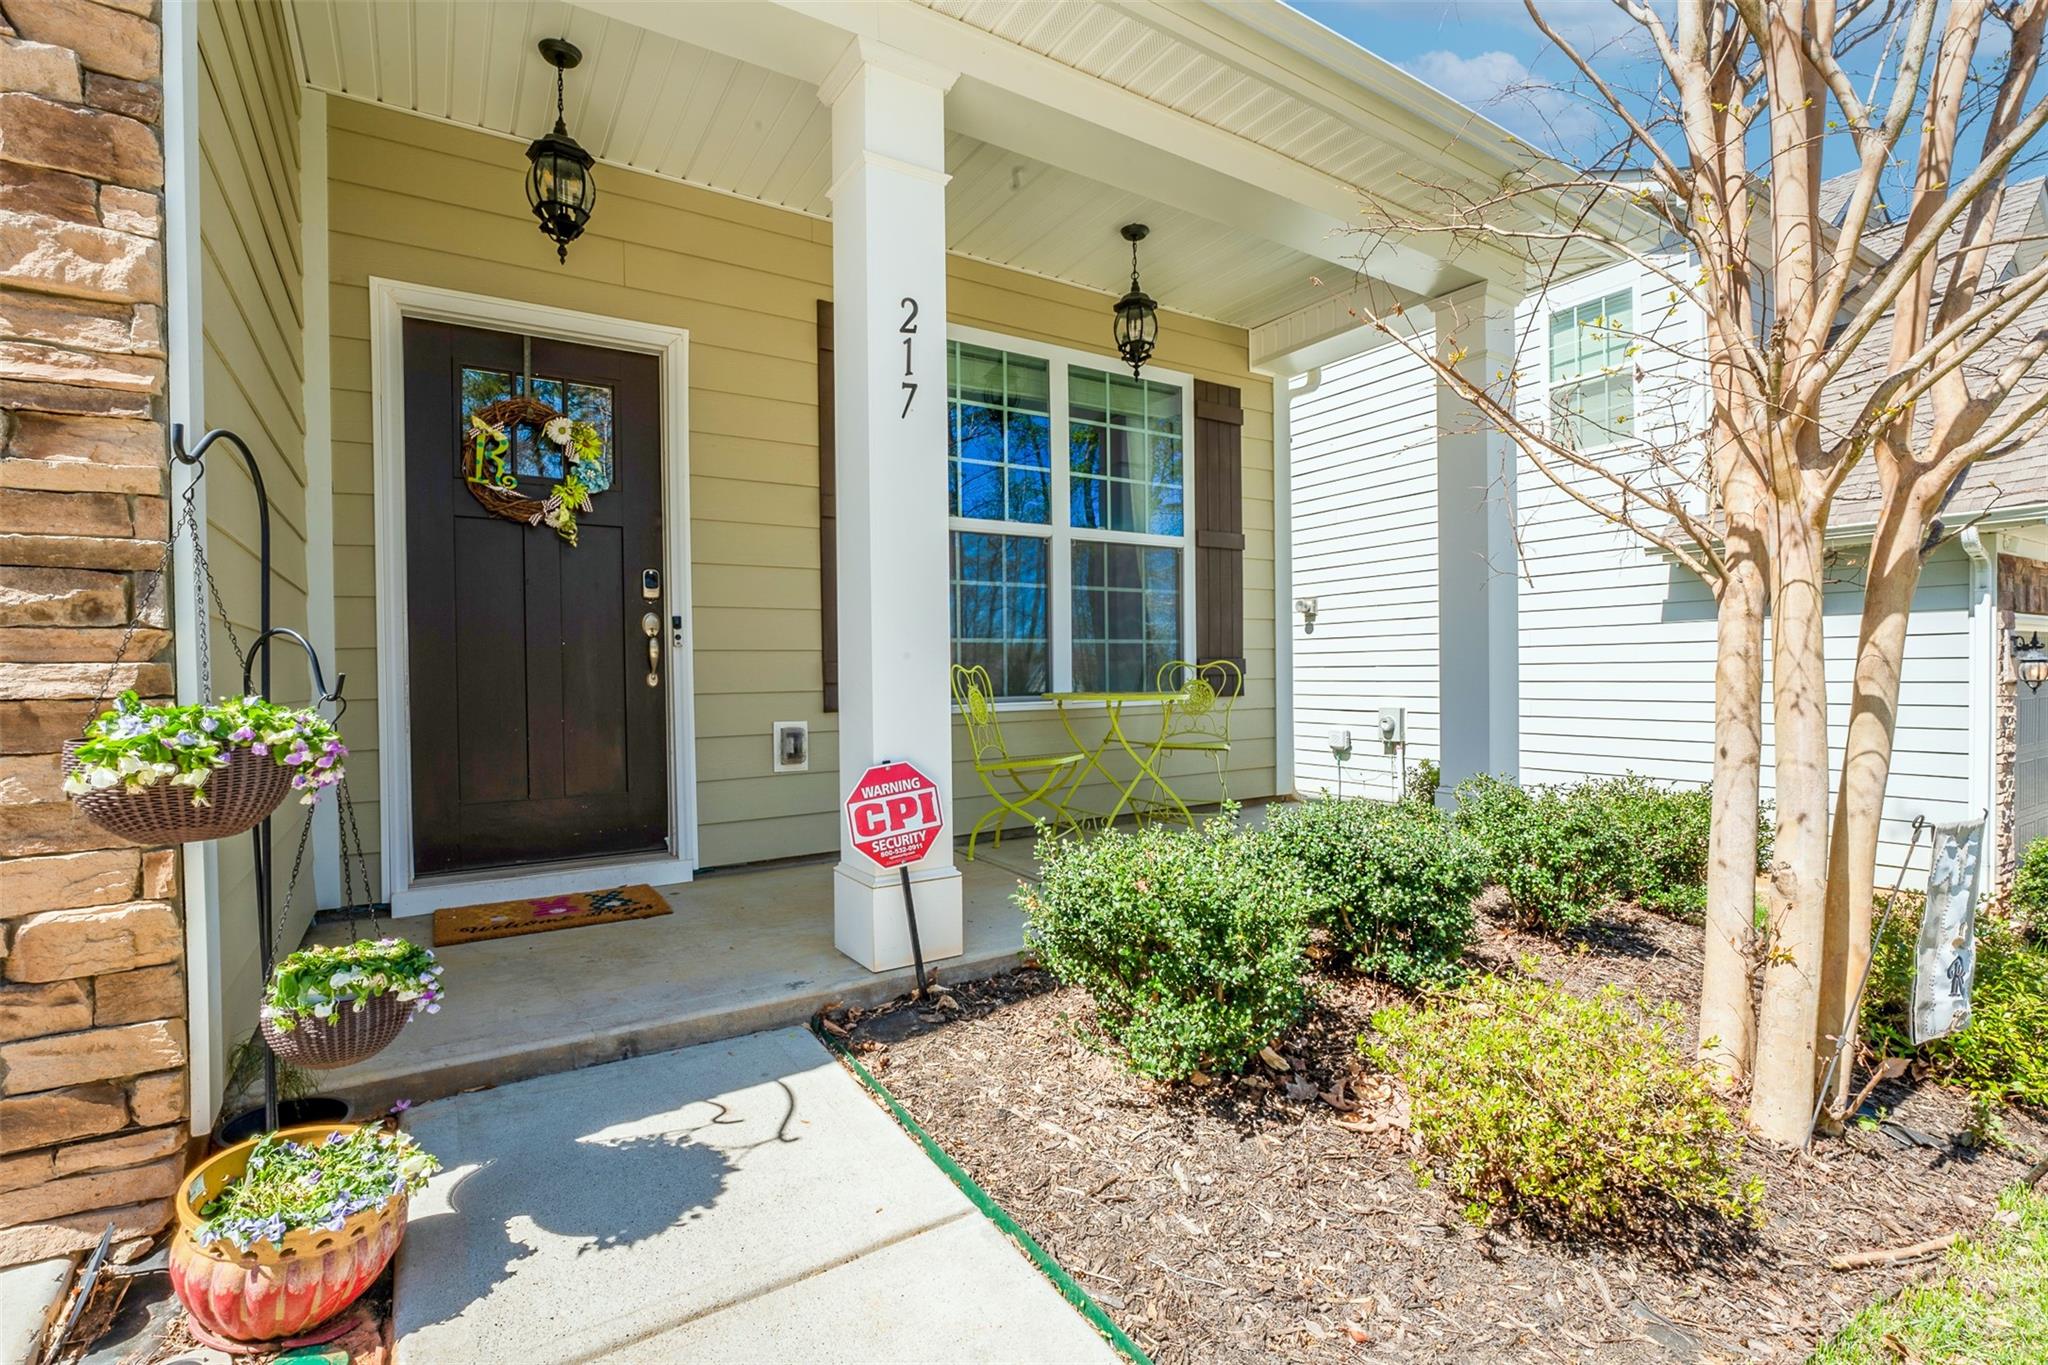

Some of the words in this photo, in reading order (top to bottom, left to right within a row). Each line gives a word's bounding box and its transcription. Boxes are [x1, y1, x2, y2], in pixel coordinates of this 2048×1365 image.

[899, 297, 919, 419] 217
[861, 777, 921, 799] WARNING
[854, 791, 937, 838] CPI
[871, 830, 927, 853] SECURITY
